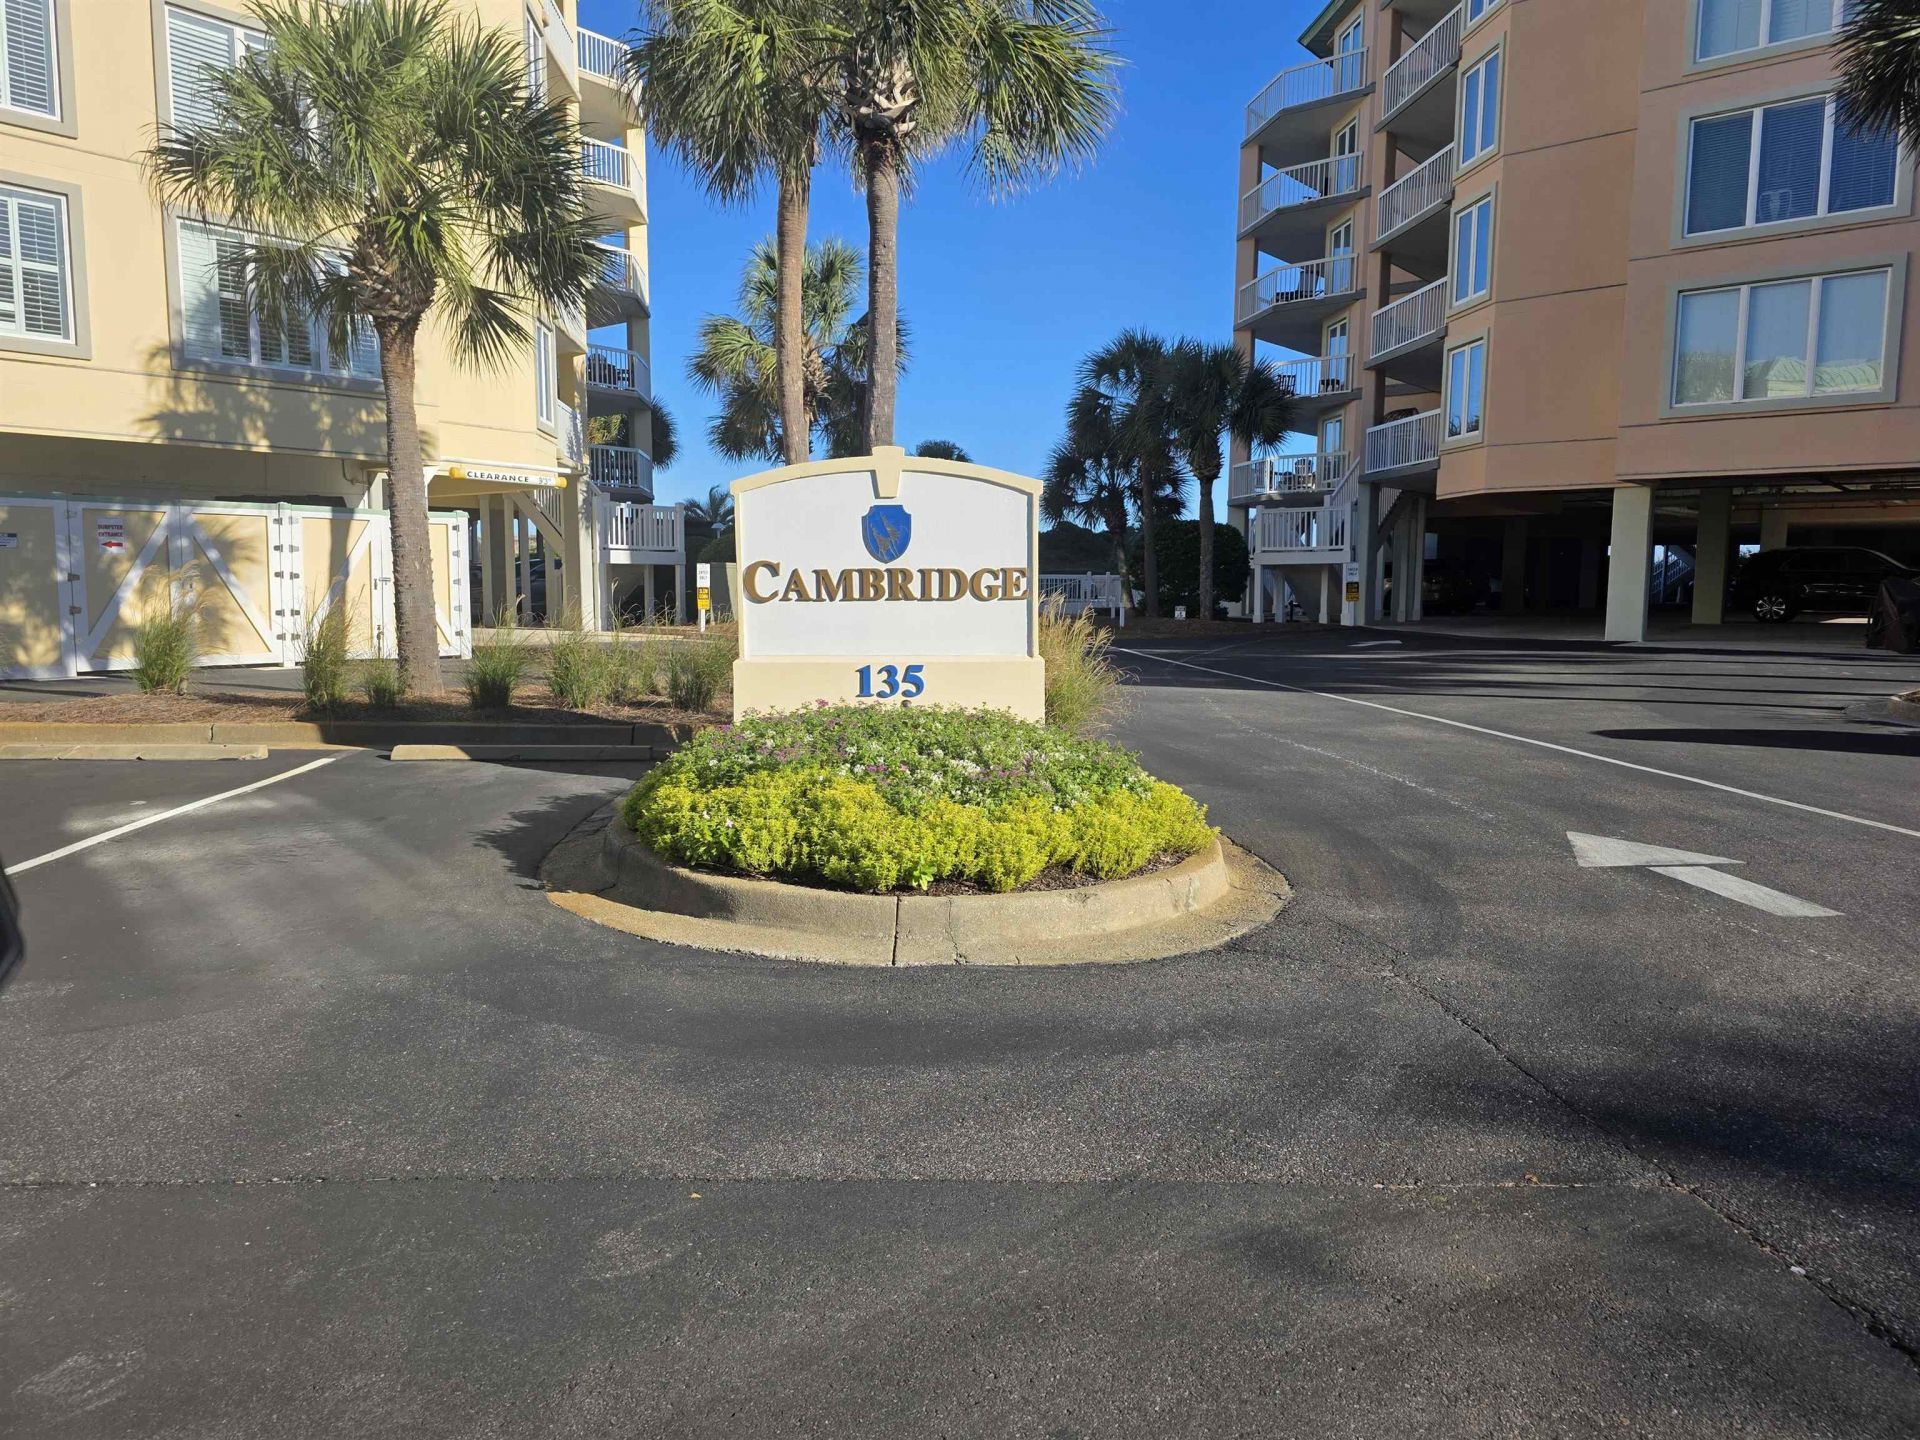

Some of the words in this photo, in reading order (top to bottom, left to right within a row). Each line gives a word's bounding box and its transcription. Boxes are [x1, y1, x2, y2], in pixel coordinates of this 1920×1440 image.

[467, 471, 529, 482] CLEARANCE
[743, 560, 1028, 604] CAMBRIDGE
[855, 664, 925, 699] 135
